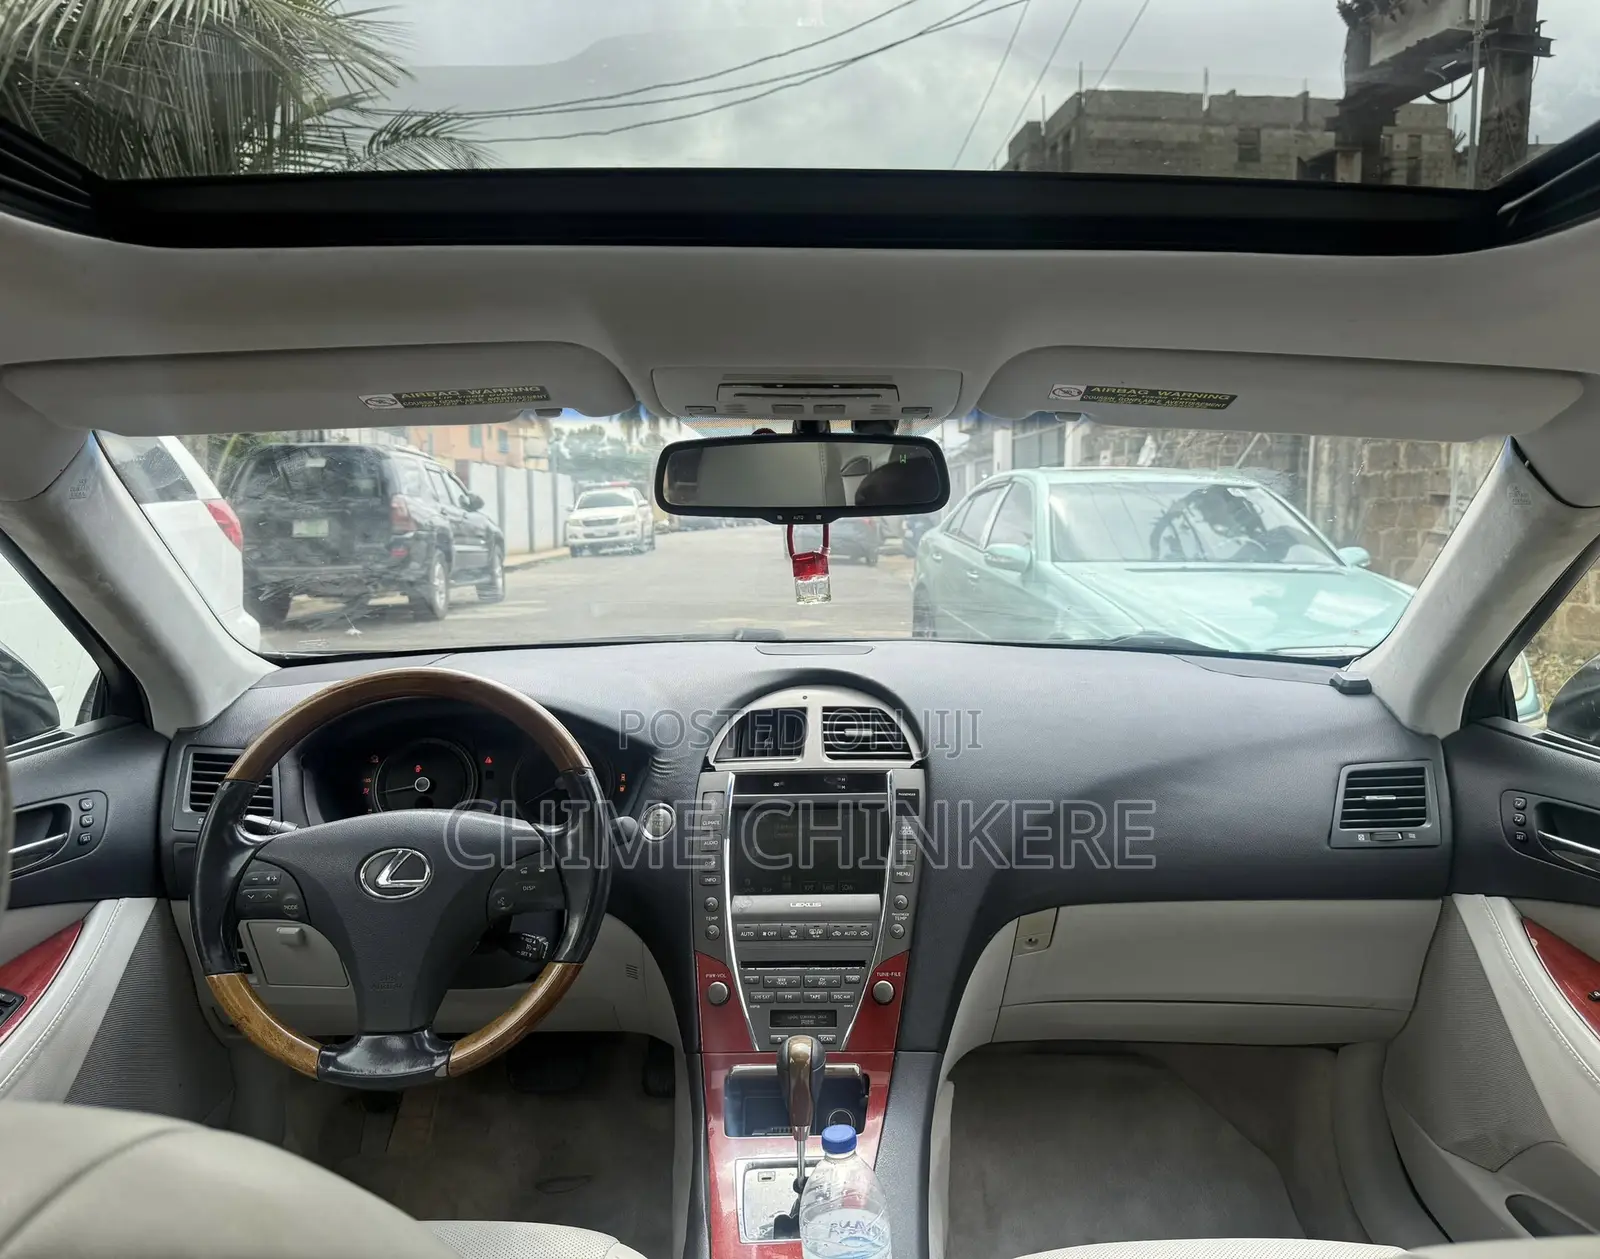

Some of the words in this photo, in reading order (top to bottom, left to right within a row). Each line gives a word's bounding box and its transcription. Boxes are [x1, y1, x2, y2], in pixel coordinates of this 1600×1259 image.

[401, 390, 460, 399] AIRBAG
[467, 386, 541, 395] WARNING
[1091, 386, 1149, 395] AIRBAG
[1156, 390, 1231, 400] WARNING
